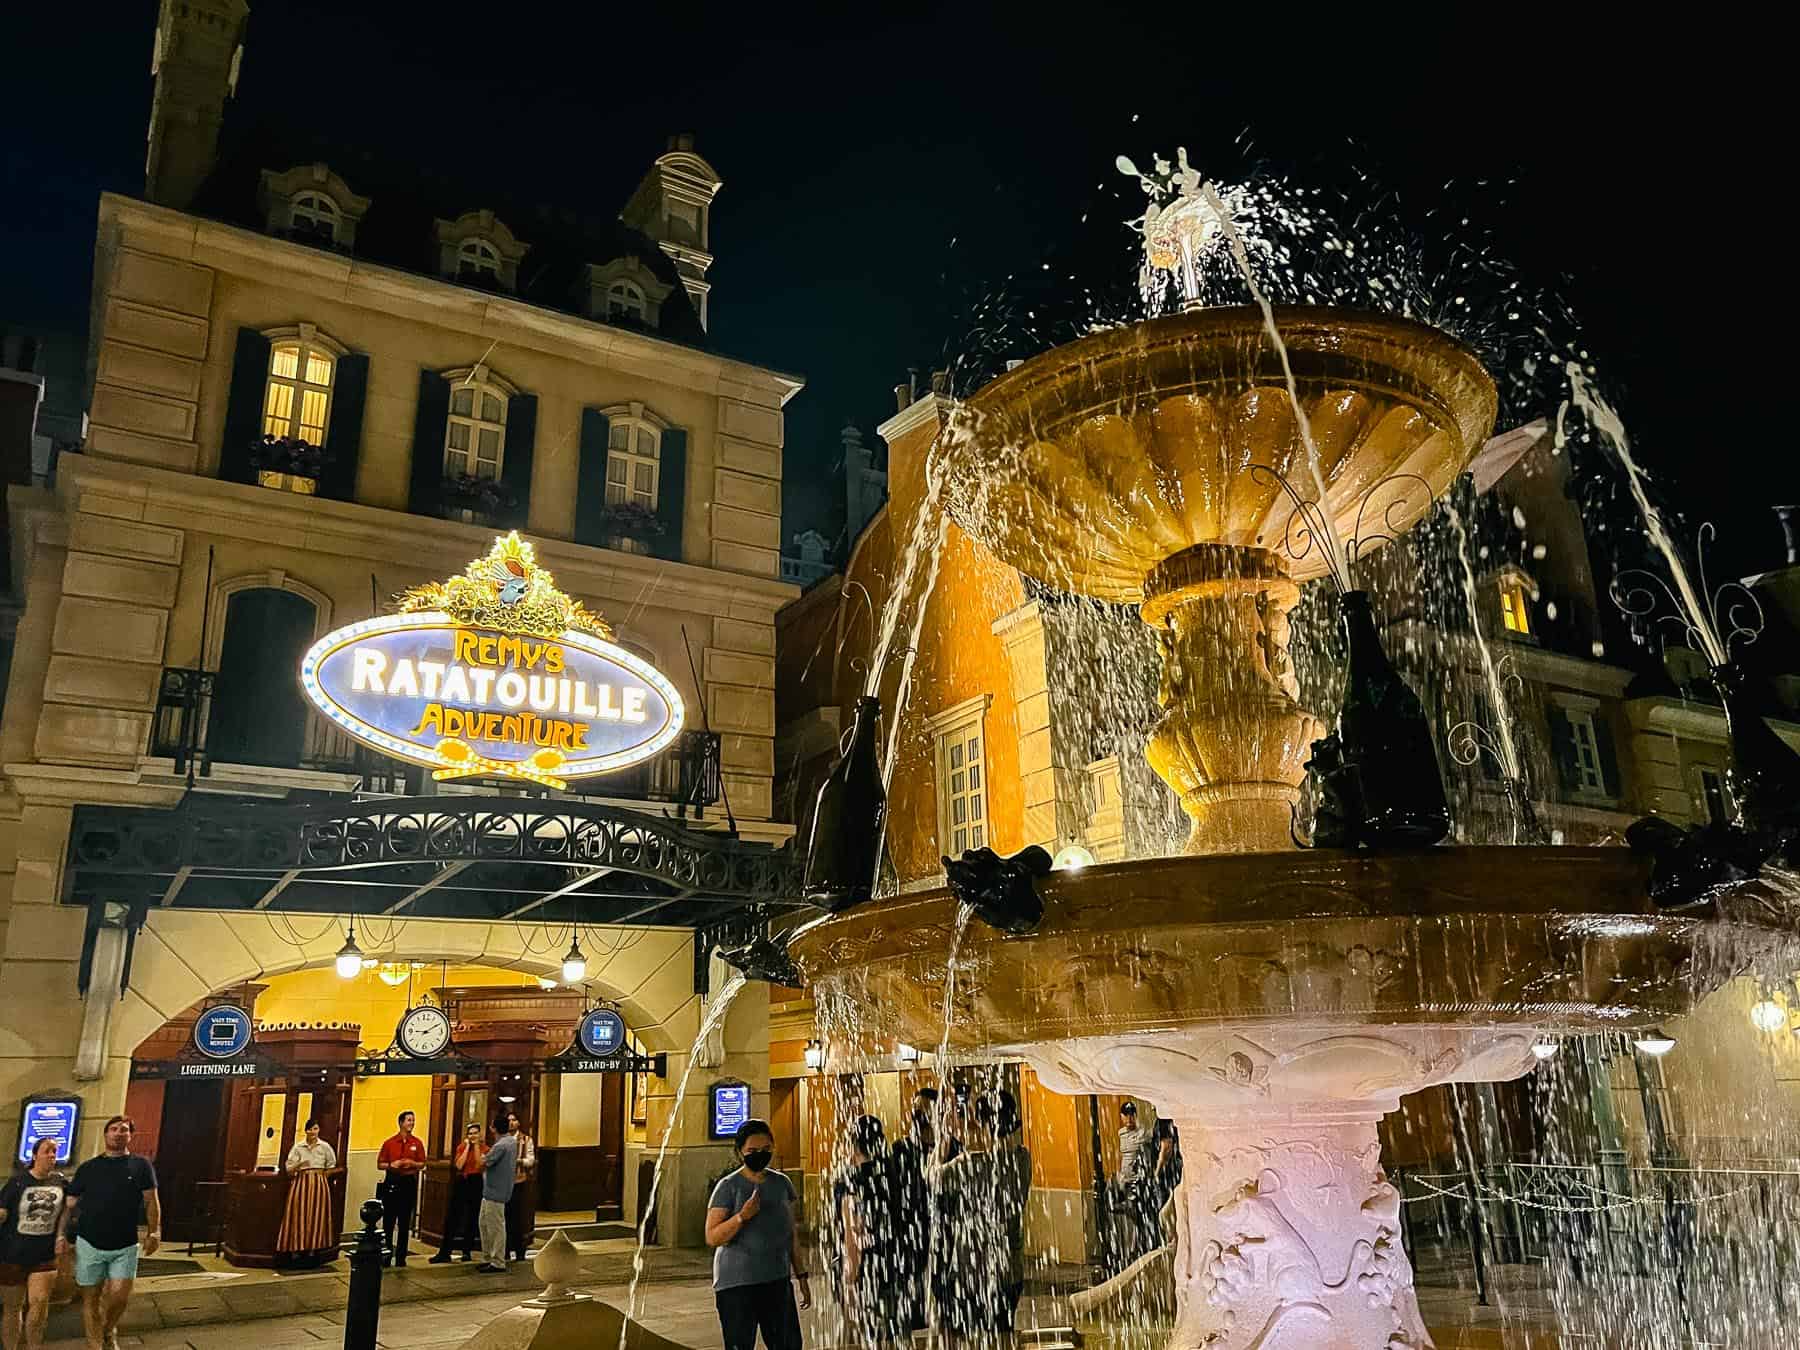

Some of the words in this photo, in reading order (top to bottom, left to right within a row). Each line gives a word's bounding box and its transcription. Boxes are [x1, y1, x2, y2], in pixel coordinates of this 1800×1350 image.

[453, 630, 566, 672] REMY'S
[351, 647, 647, 722] RATATOUILLE
[409, 703, 591, 751] ADVENTURE
[181, 1063, 231, 1075] LIGHTNING
[232, 1063, 256, 1074] LANE
[578, 1060, 620, 1070] STAND-BY
